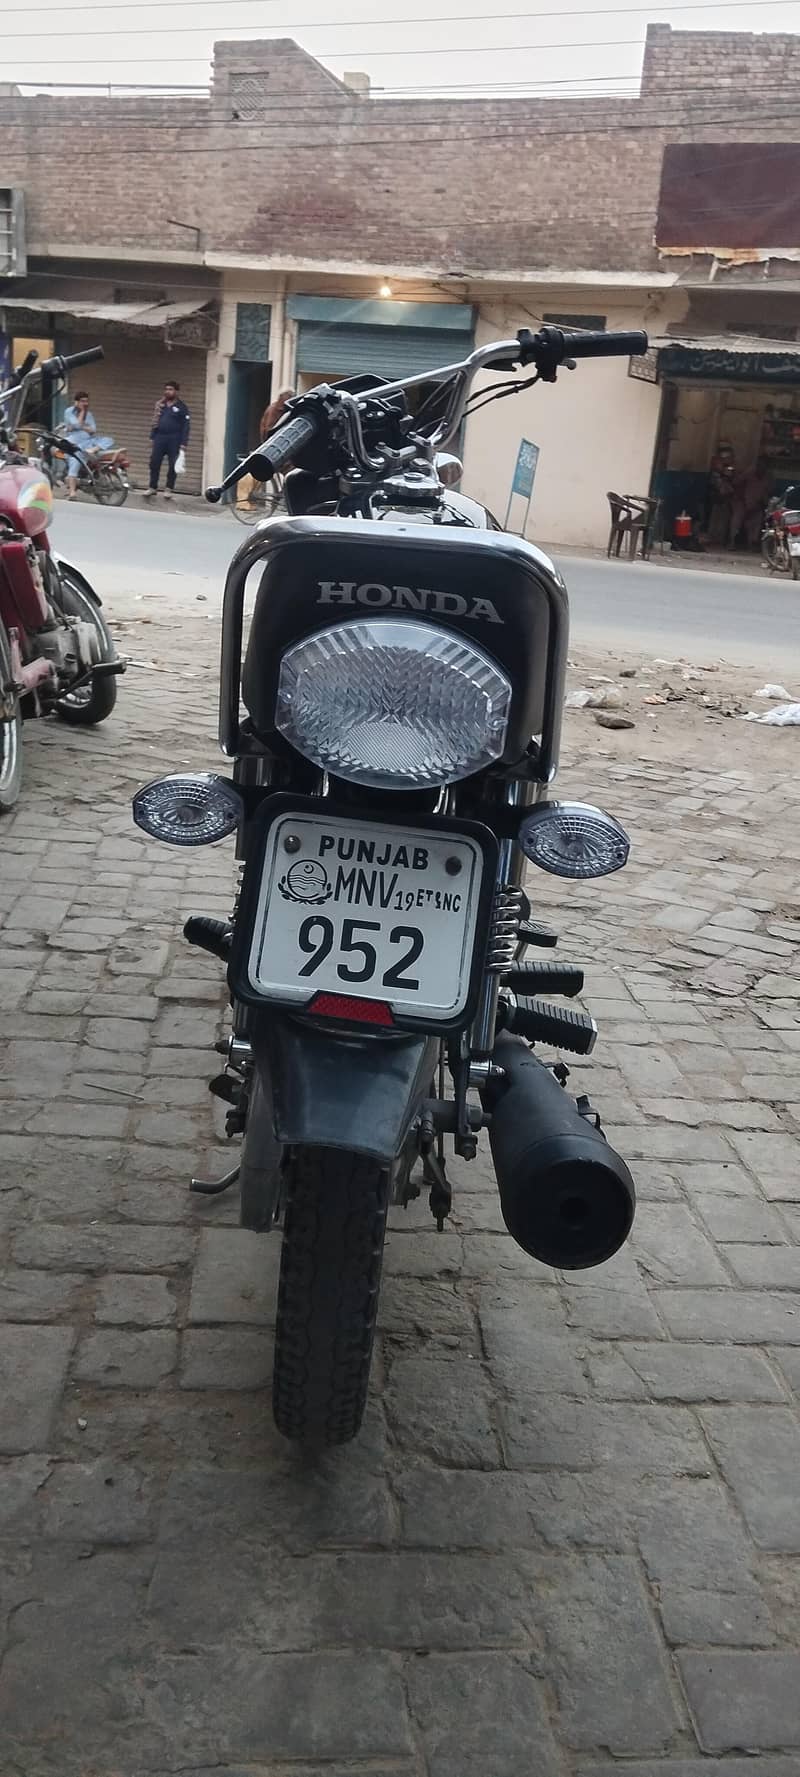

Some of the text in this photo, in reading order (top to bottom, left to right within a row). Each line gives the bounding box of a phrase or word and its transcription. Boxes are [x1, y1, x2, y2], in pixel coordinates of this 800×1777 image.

[316, 582, 505, 624] HONDA
[318, 835, 429, 870] PUNJAB
[334, 865, 399, 908] MNV
[394, 890, 415, 911] 19
[298, 915, 424, 990] 952
